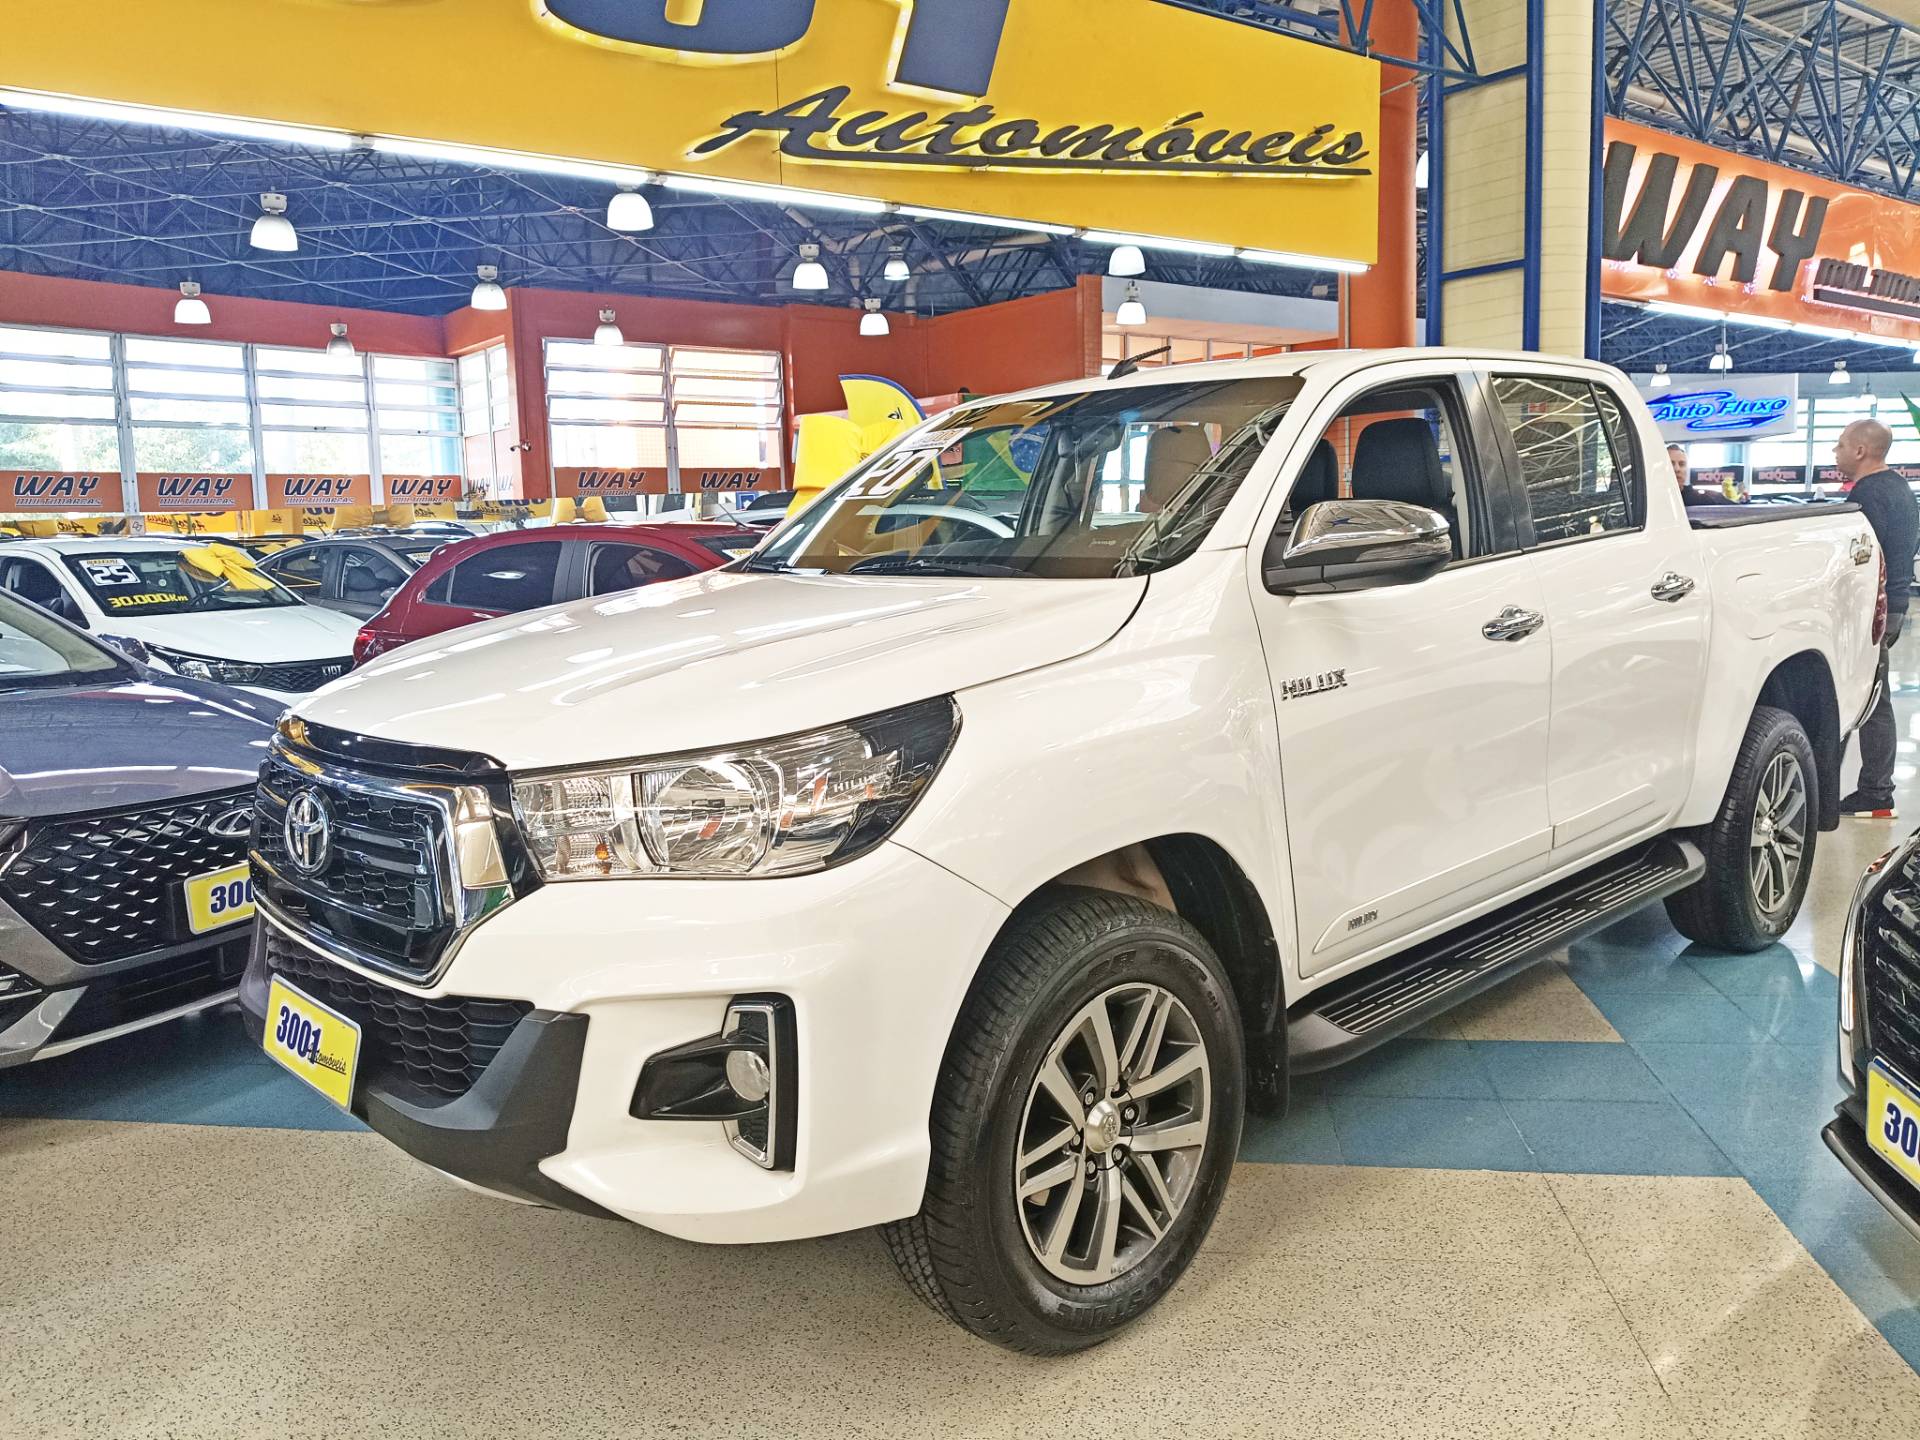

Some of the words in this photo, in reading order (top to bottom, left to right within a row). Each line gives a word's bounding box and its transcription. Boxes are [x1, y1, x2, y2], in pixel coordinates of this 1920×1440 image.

[693, 86, 1371, 174] Automóveis
[1601, 141, 1829, 291] WAY
[1653, 401, 1714, 422] Auto
[1717, 397, 1789, 417] Fluxo
[14, 475, 101, 497] WAY
[157, 477, 235, 497] WAY
[284, 477, 353, 497] WAY
[390, 478, 455, 497] WAY
[577, 471, 645, 490] WAY
[701, 472, 761, 490] WAY
[90, 566, 137, 583] 25
[108, 593, 188, 608] 30.000Km
[1280, 667, 1347, 701] HILUX
[276, 1005, 322, 1064] 3001
[1884, 1102, 1920, 1164] 30
